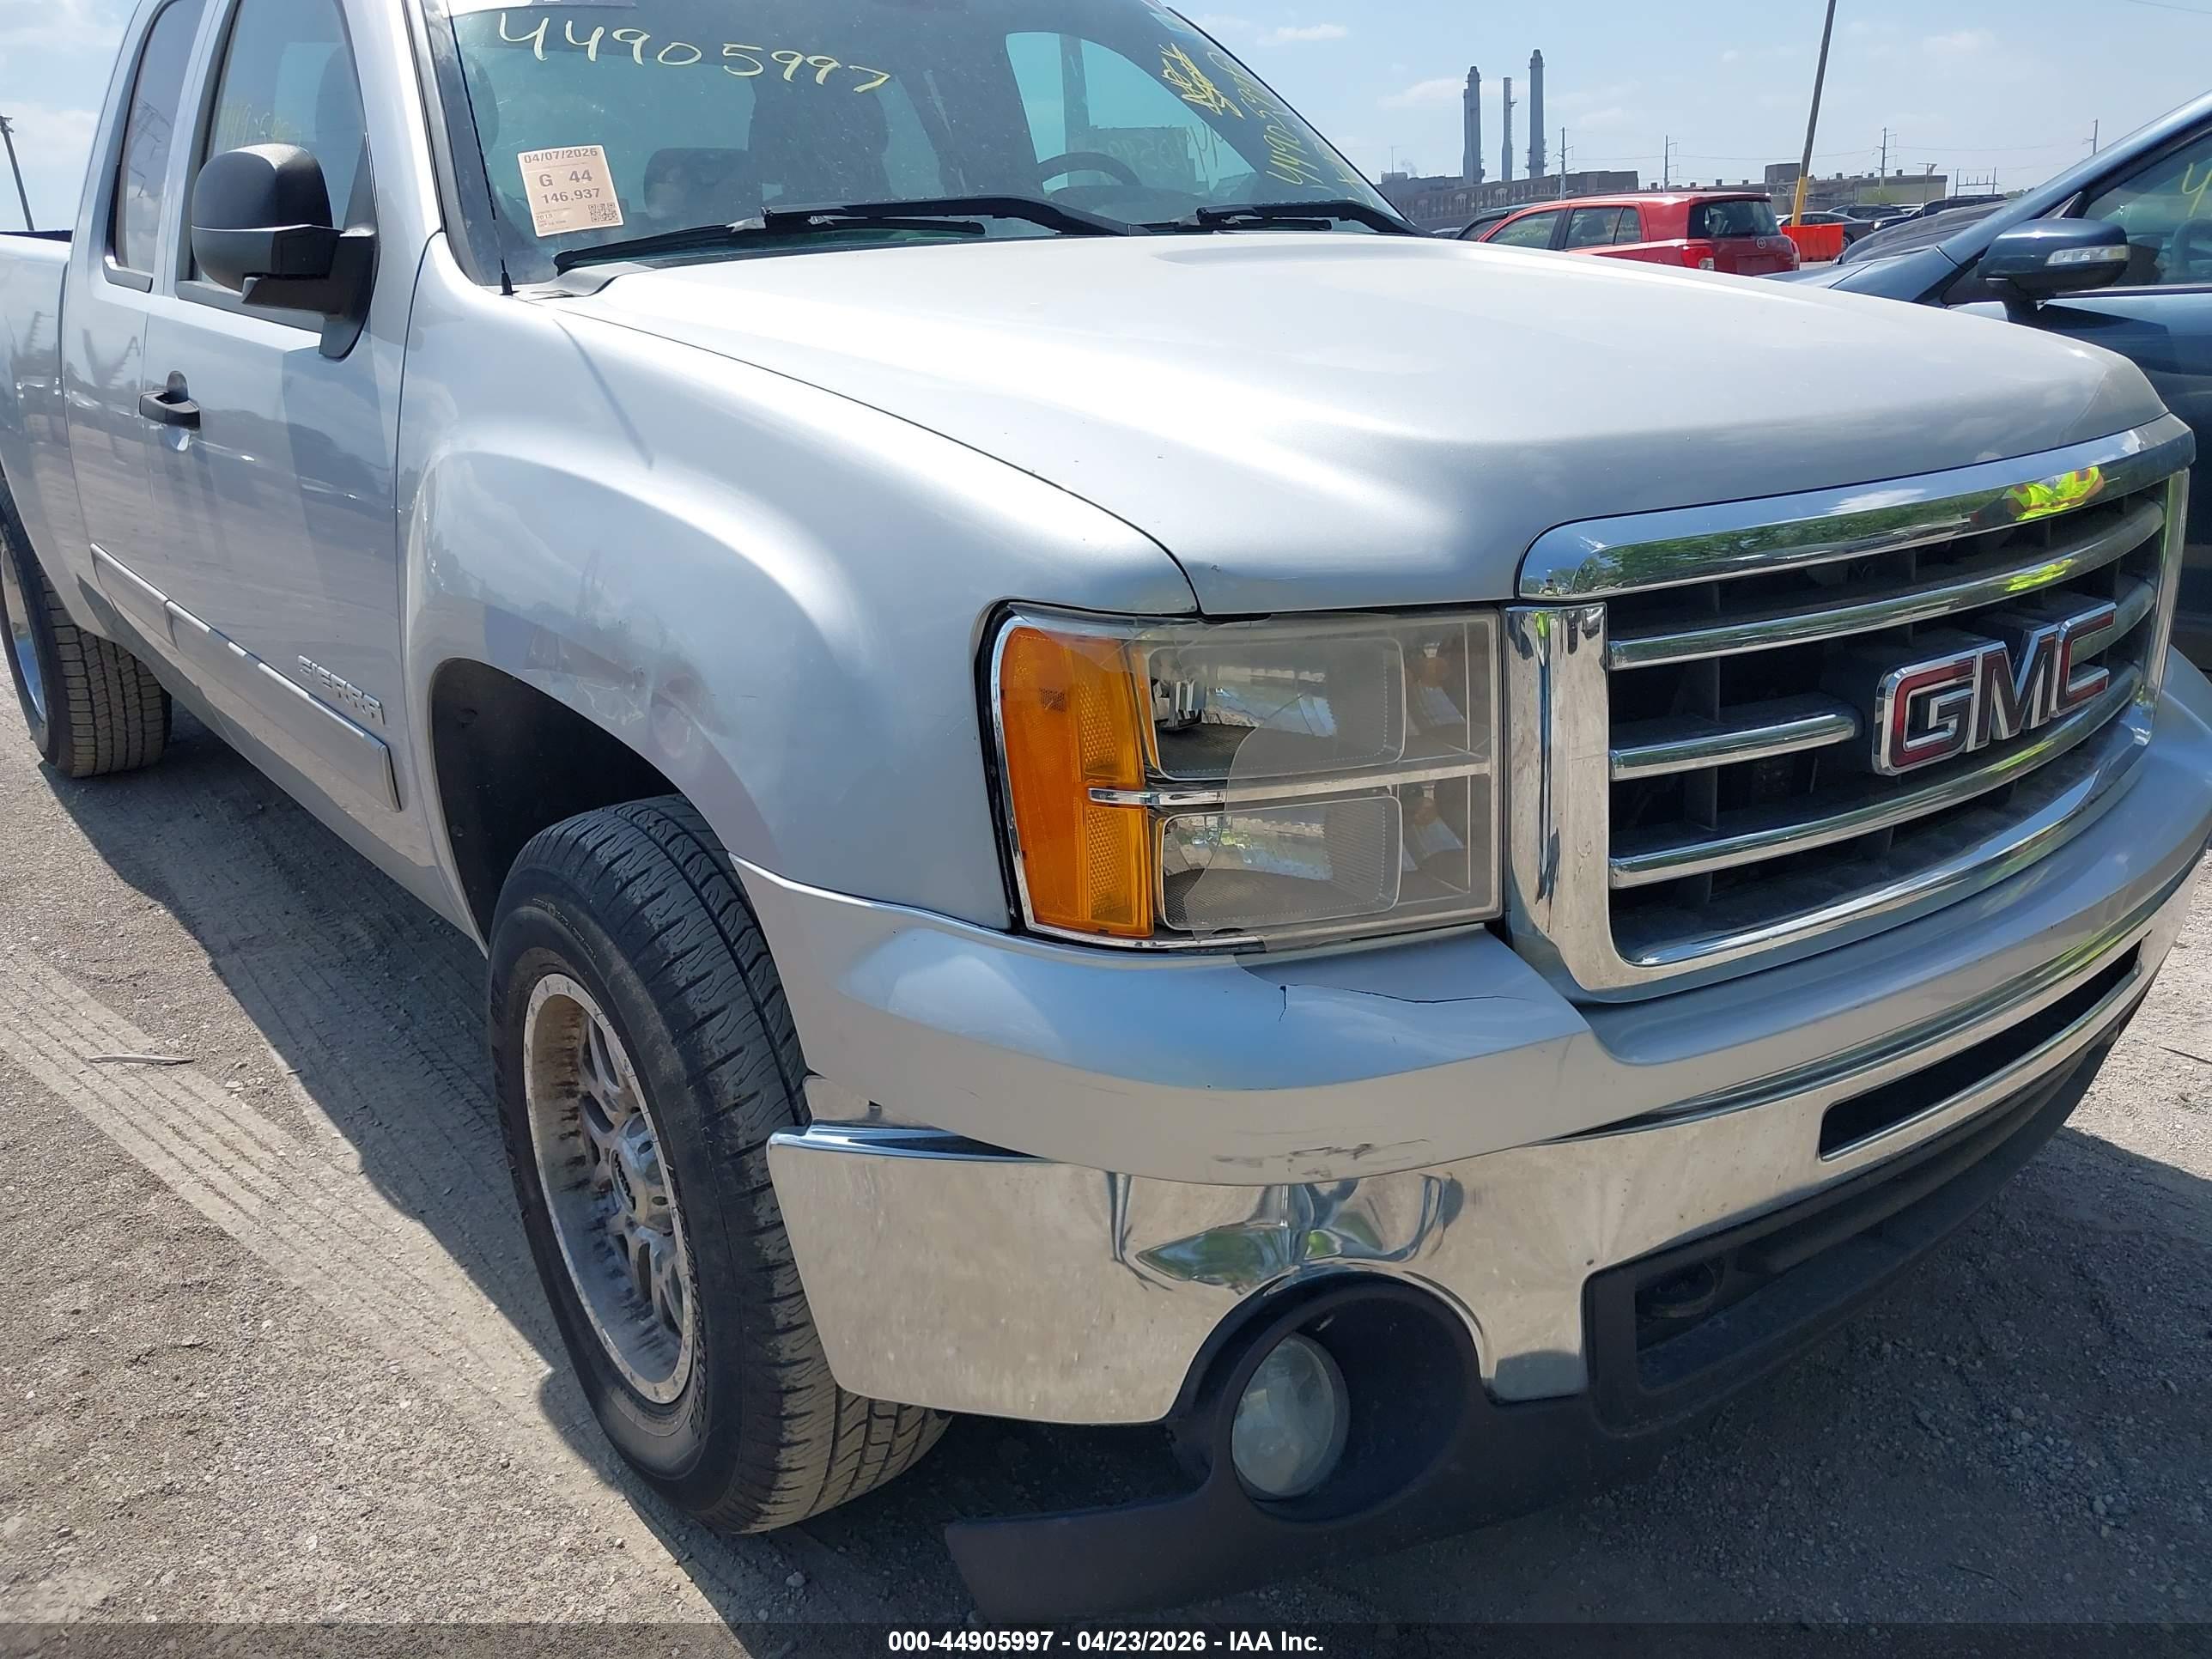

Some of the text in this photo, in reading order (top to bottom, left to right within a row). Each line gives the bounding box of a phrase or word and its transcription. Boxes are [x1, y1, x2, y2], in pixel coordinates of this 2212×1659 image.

[524, 148, 598, 164] 04/07/2026
[539, 169, 592, 187] G 44
[542, 188, 600, 204] 146.937
[1873, 603, 2117, 775] GMC
